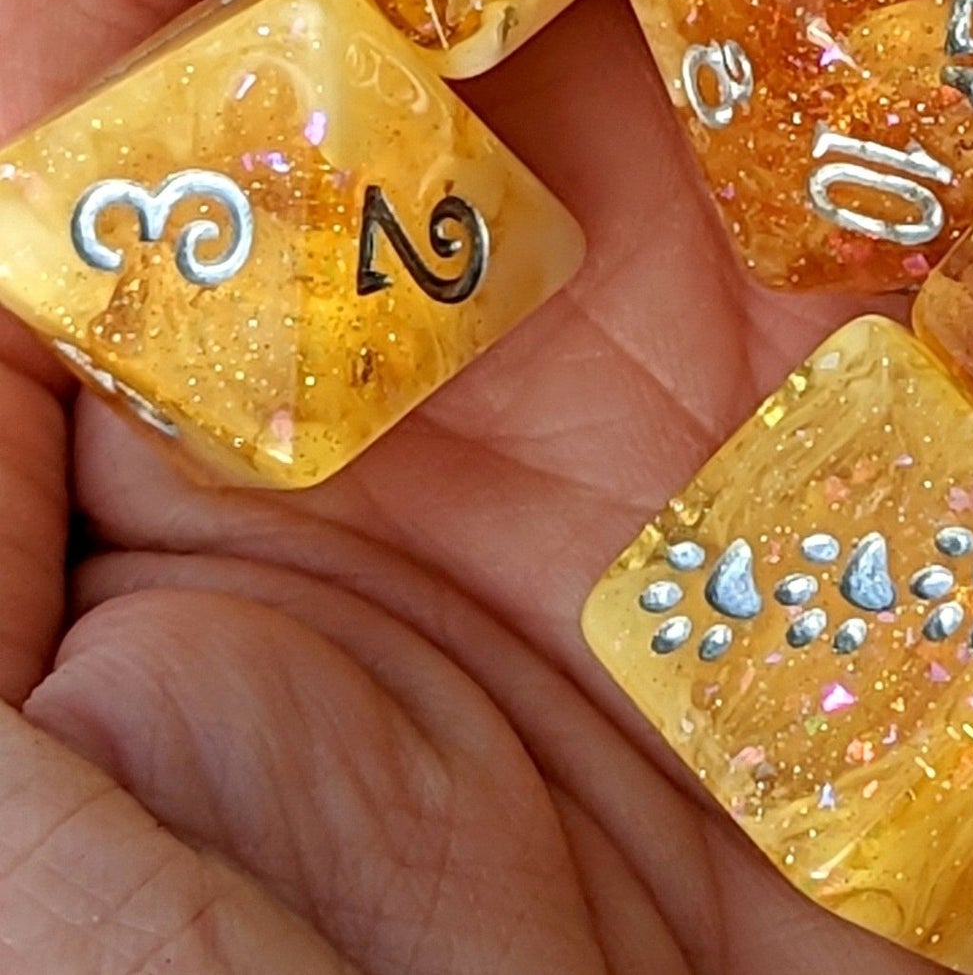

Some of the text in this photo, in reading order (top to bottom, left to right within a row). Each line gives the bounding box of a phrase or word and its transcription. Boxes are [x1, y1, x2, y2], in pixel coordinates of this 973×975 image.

[71, 169, 253, 286] 3
[808, 125, 953, 244] 10
[357, 185, 490, 304] 2
